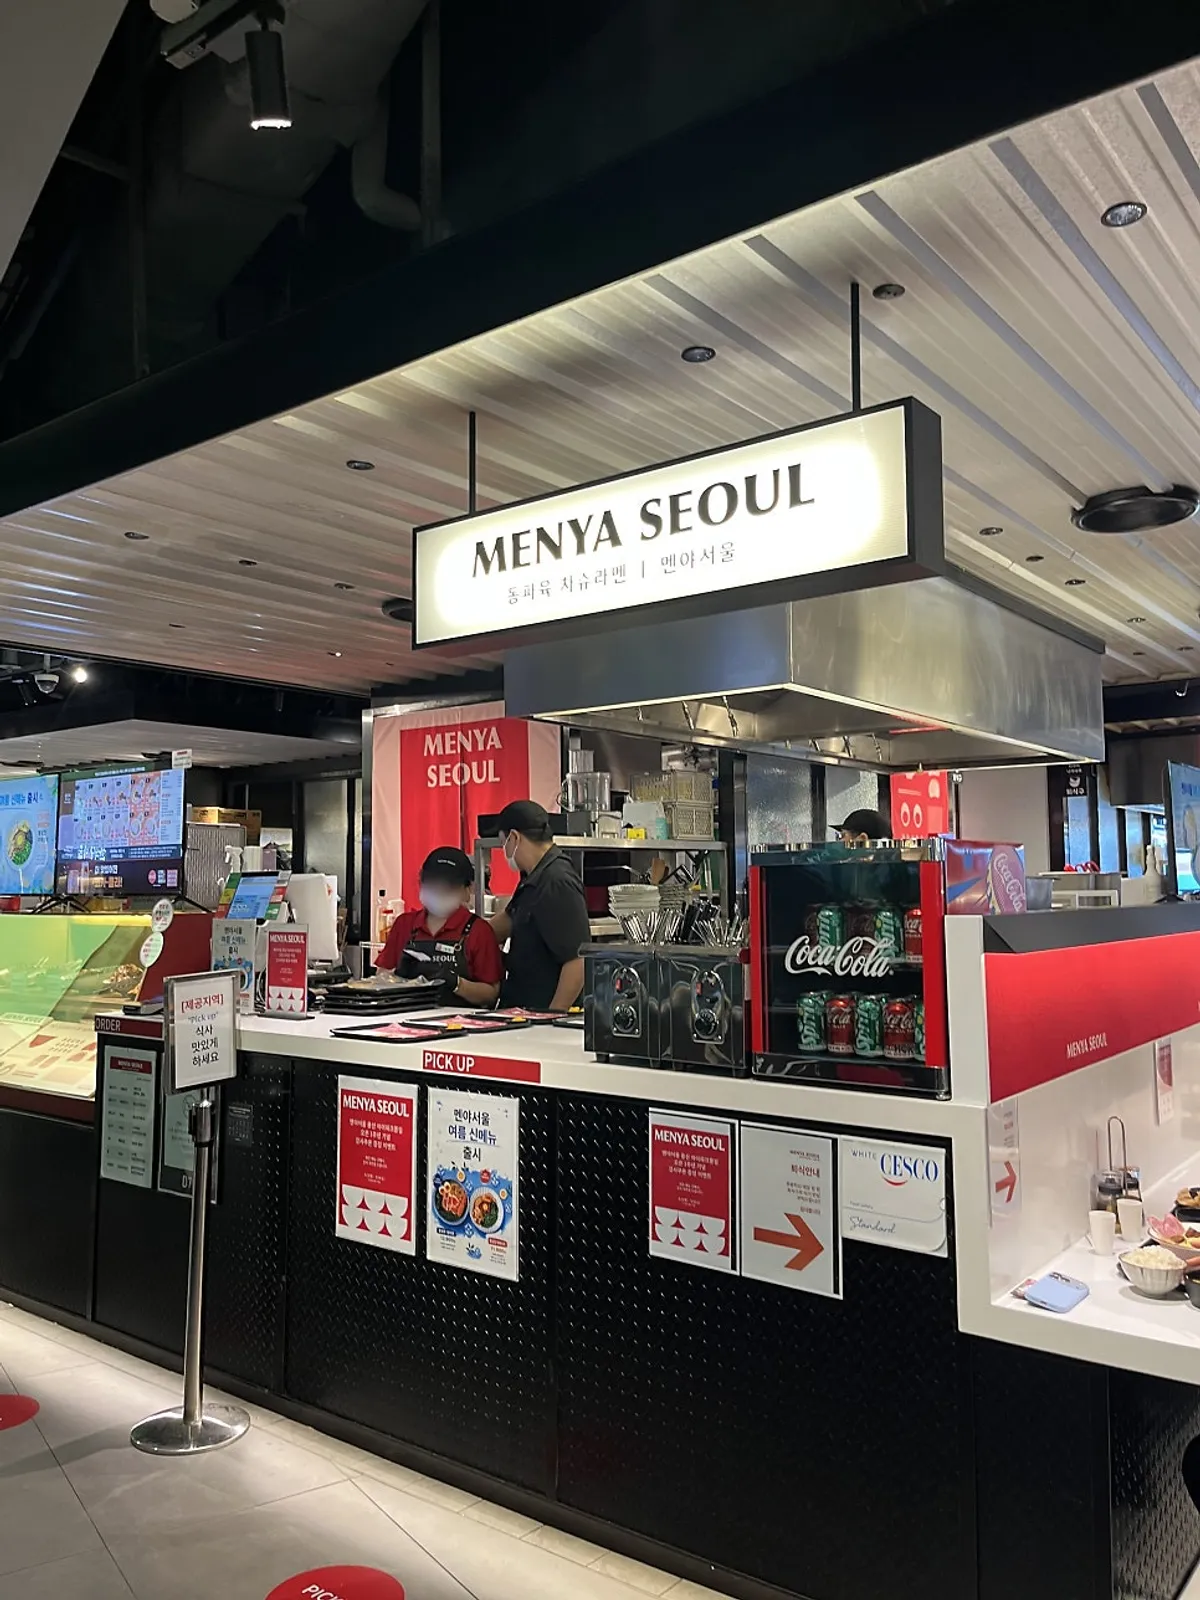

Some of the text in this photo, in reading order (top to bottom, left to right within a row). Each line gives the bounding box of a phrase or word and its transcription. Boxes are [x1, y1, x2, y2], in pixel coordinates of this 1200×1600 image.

[472, 463, 815, 578] MENYA SEOUL
[660, 541, 735, 574] 멘야서울
[424, 726, 502, 756] MENYA
[427, 759, 500, 788] SEOUL
[181, 993, 224, 1013] [제공지역]
[95, 1018, 121, 1032] ORDER
[196, 1024, 213, 1036] 식사
[191, 1037, 219, 1053] 맛있게
[1066, 1032, 1108, 1059] MENYA SEOUL
[192, 1052, 219, 1067] 하세요
[424, 1052, 475, 1072] PICK UP
[343, 1094, 409, 1117] MENYA SEOUL
[454, 1109, 490, 1126] 멘야서울
[448, 1124, 496, 1146] 여름 신메뉴
[655, 1128, 725, 1152] MENYA SEOUL
[463, 1146, 481, 1162] 출시
[880, 1153, 939, 1182] CESCO
[849, 1215, 896, 1234] Standard
